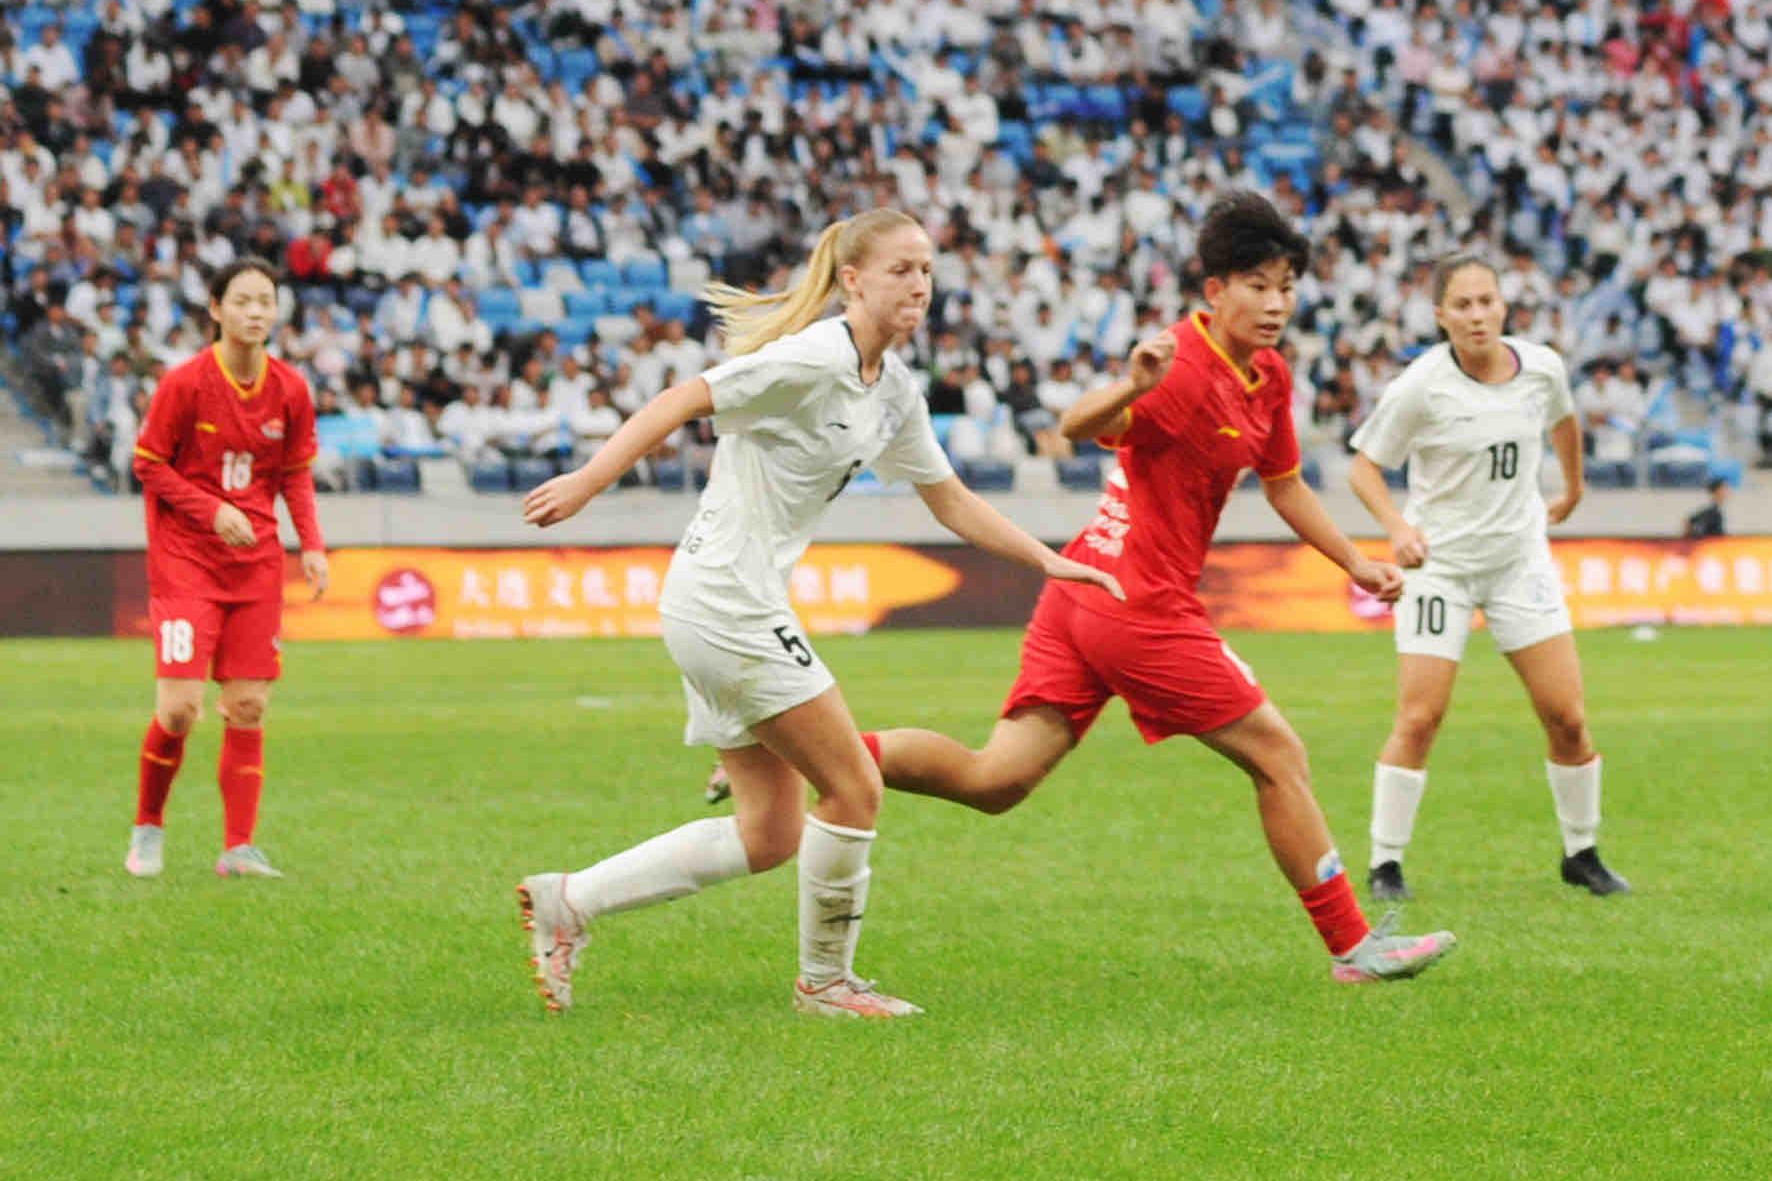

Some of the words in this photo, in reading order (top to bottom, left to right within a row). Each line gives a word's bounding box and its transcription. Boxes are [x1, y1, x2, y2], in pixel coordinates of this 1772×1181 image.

[1488, 441, 1518, 481] 10
[1415, 595, 1446, 635] 10
[160, 619, 194, 664] 18
[773, 625, 812, 667] 5
